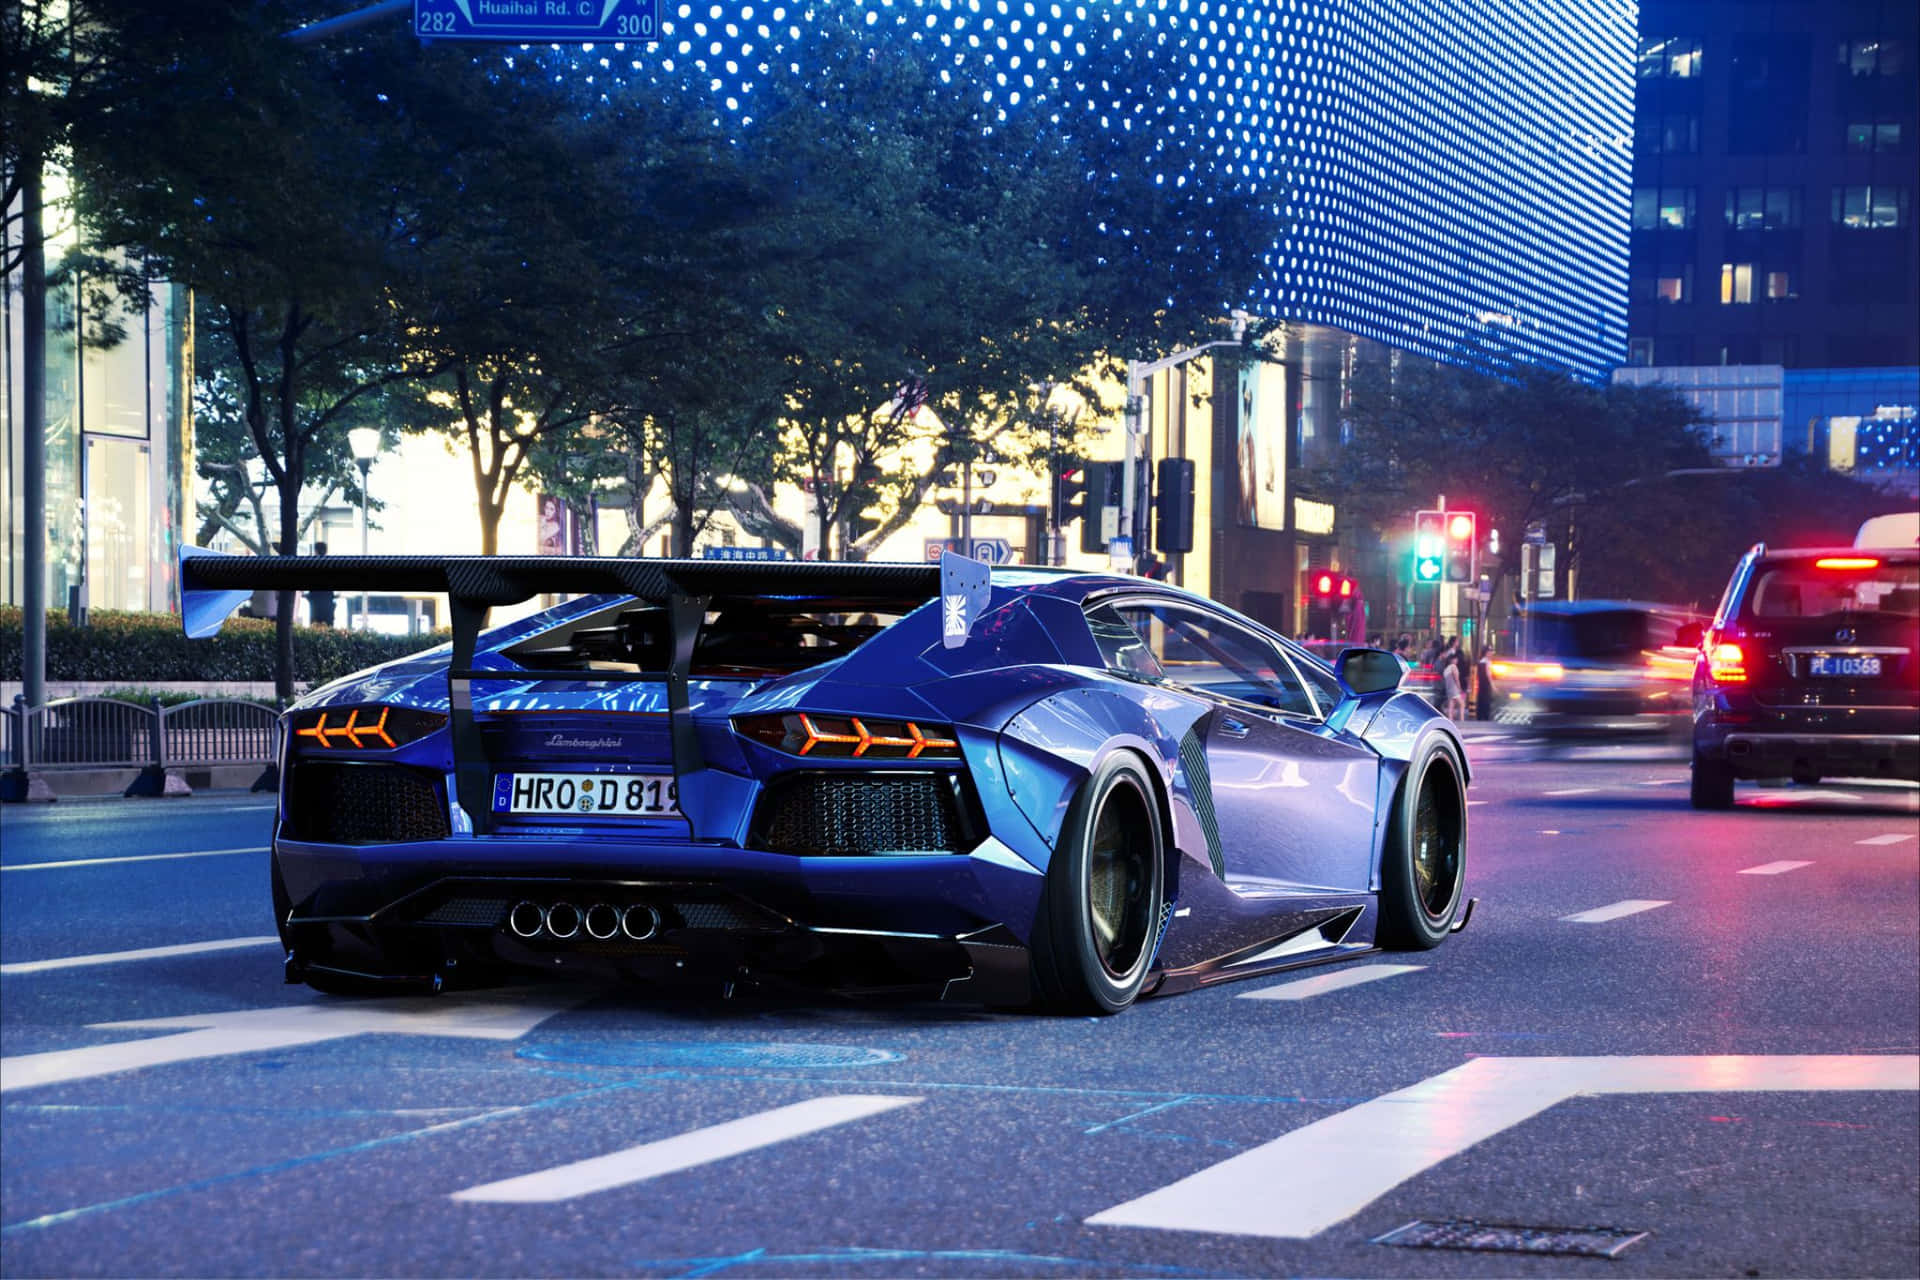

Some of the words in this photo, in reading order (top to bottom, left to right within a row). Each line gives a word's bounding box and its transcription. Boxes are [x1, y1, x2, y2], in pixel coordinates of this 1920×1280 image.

[479, 0, 538, 15] Huaihai
[545, 1, 571, 16] Rd.
[576, 0, 595, 16] (C)
[420, 11, 456, 32] 282
[617, 15, 652, 35] 300
[544, 734, 623, 750] Lamborghini
[512, 777, 576, 810] HRO
[598, 780, 619, 810] D
